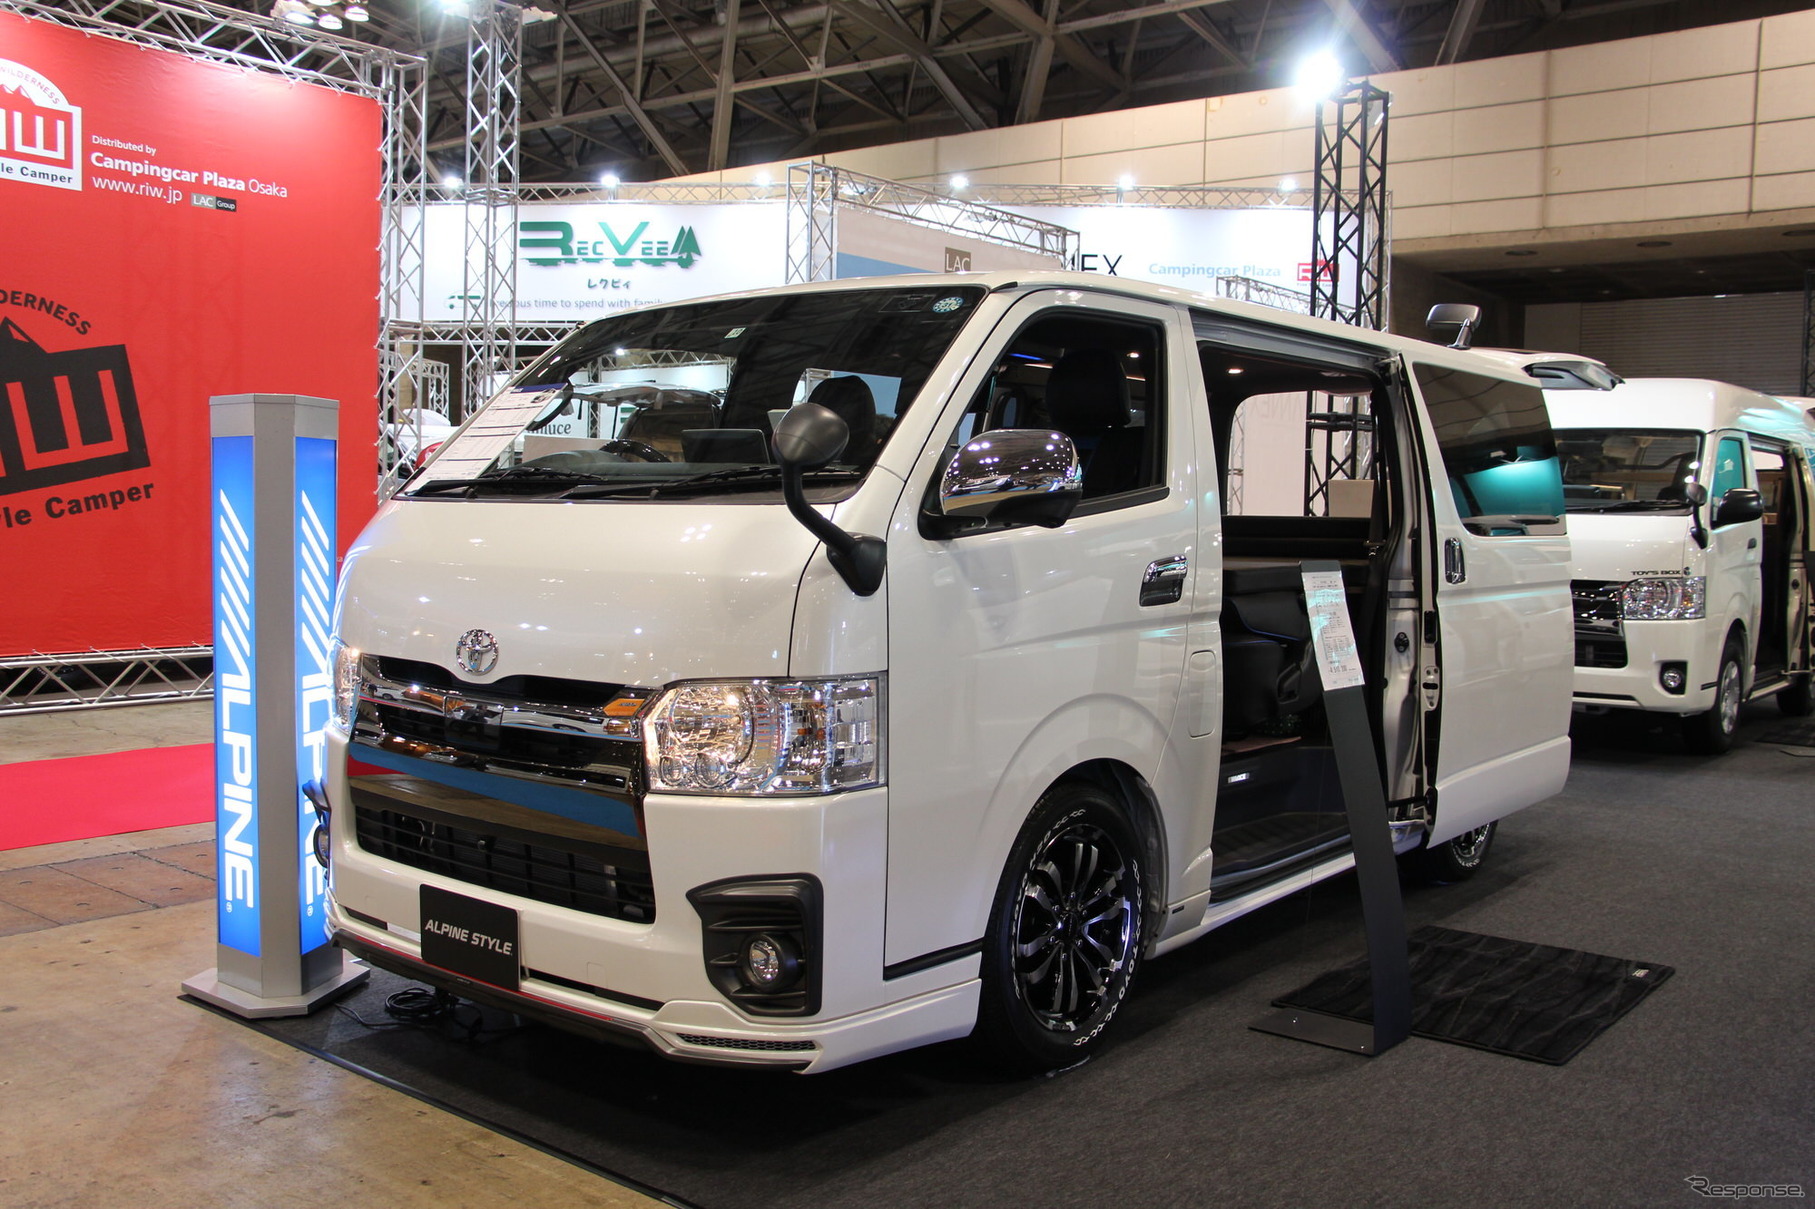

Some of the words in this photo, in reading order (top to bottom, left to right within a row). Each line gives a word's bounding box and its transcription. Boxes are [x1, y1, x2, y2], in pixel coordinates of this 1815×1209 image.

[92, 135, 143, 152] Distributed
[145, 144, 156, 156] by
[20, 166, 73, 184] Camper
[90, 152, 199, 182] Campingcar
[203, 171, 246, 191] Plaza
[248, 178, 288, 198] Osaka
[92, 176, 183, 204] www.riw.jp
[193, 195, 214, 208] LAC
[217, 200, 235, 211] Group
[945, 253, 970, 272] LAC
[1148, 263, 1237, 278] Campingcar
[1243, 264, 1281, 277] Plaza
[534, 298, 558, 308] time
[560, 299, 572, 308] to
[574, 297, 604, 309] spend
[607, 298, 631, 308] with
[45, 483, 154, 519] Camper
[425, 919, 470, 942] ALPINE
[470, 932, 513, 956] STYLE
